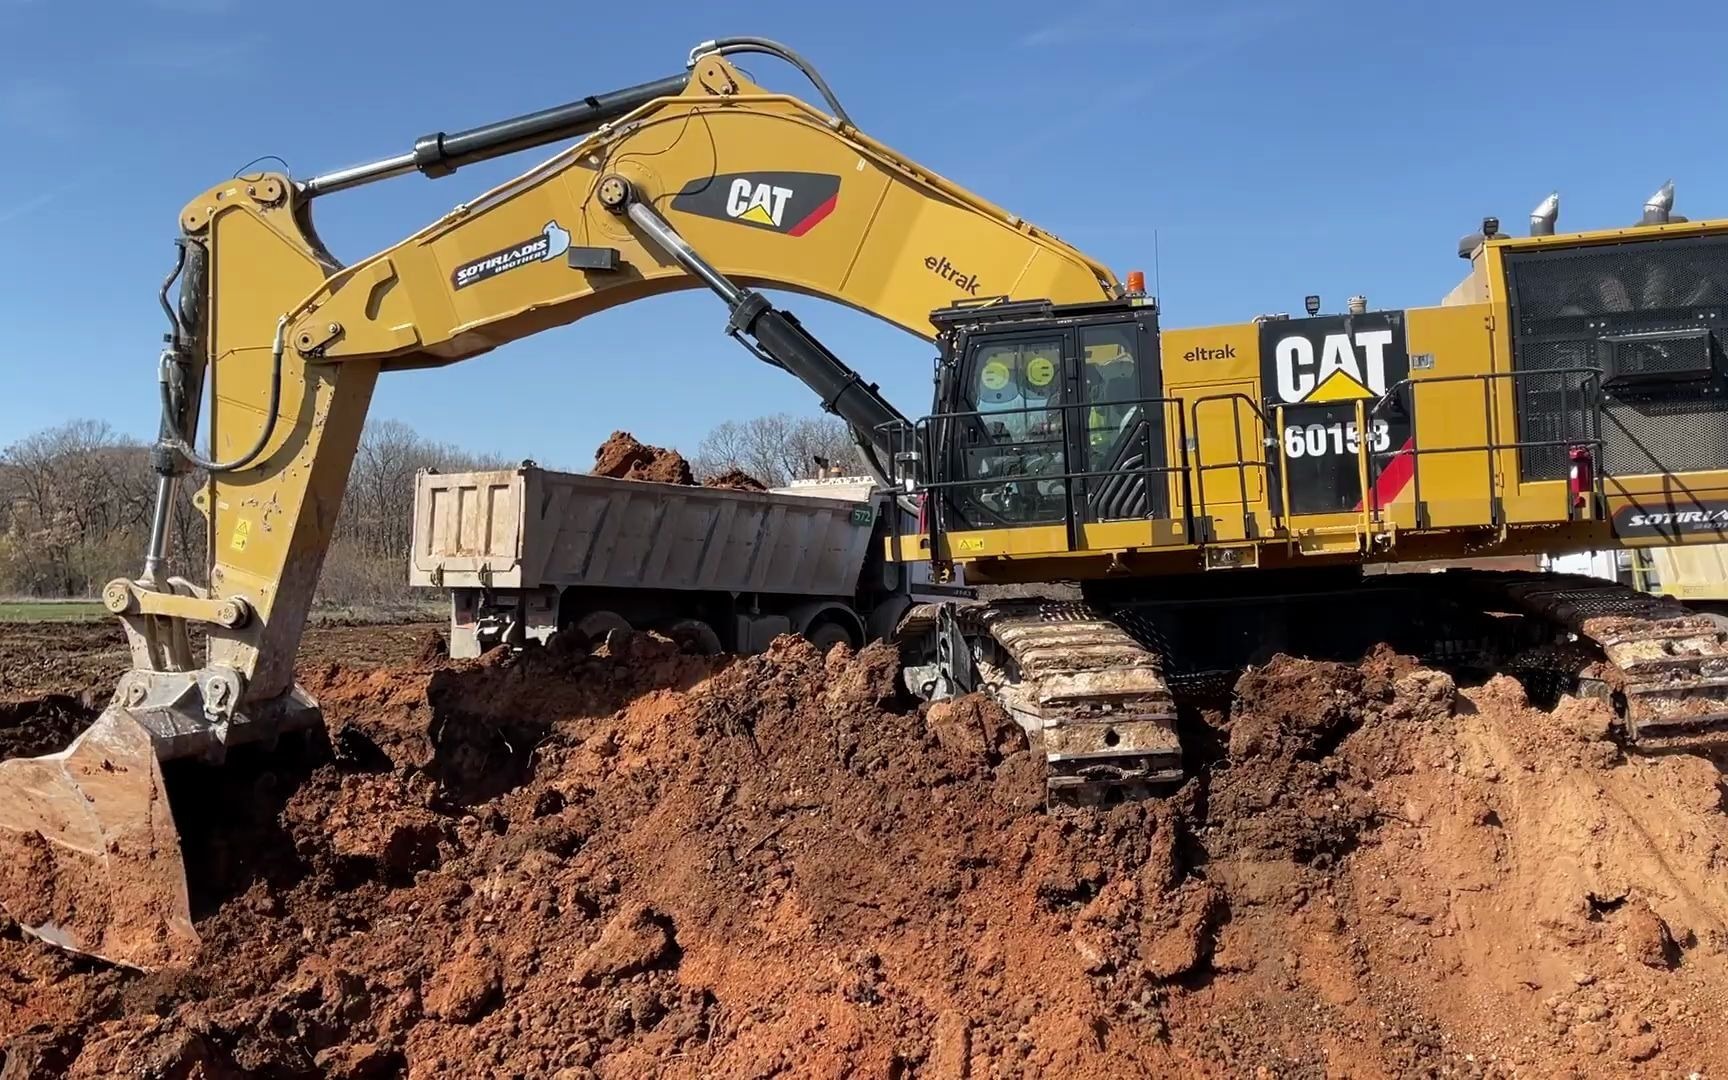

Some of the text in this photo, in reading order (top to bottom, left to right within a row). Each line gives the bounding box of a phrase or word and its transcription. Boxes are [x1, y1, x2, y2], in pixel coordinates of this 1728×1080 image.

[726, 178, 793, 227] CAT
[457, 239, 547, 281] SOTIRIADIS
[495, 249, 547, 273] BROTHERS
[924, 256, 981, 295] eltrak
[1183, 343, 1236, 361] eltrak
[1275, 330, 1393, 403] CAT
[1284, 419, 1391, 458] 6015B
